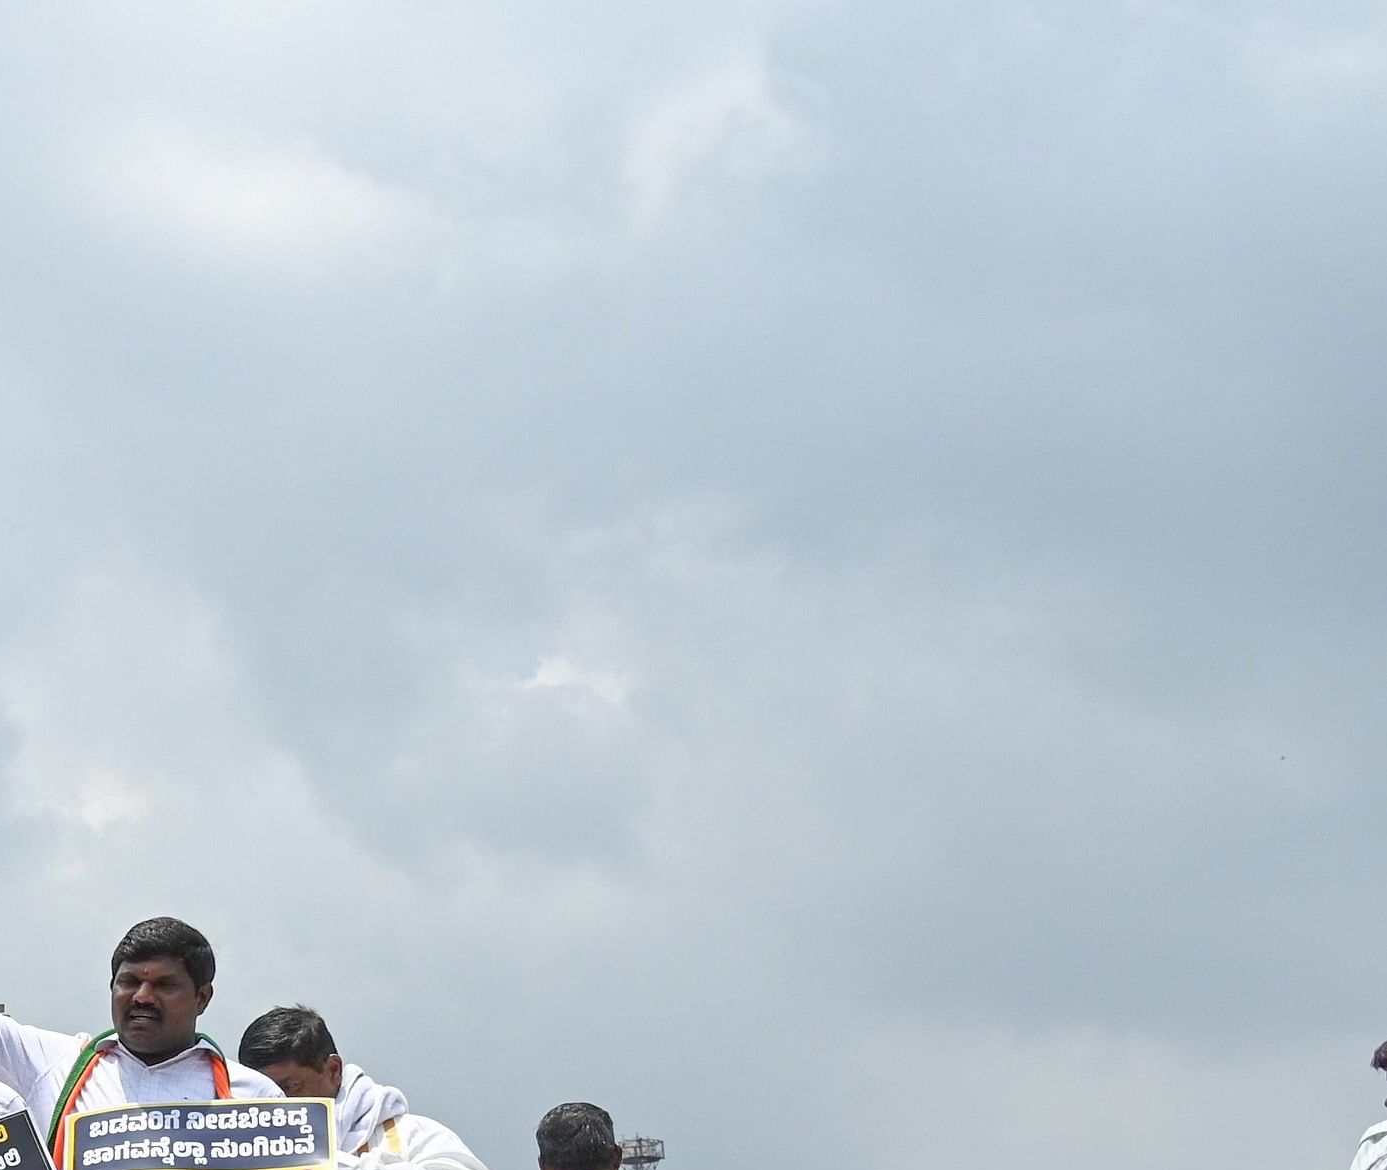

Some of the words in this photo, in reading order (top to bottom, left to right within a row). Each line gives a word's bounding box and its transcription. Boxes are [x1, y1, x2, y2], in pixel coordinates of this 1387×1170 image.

[88, 1110, 181, 1138] ಬಡವರಿಗೆ
[185, 1106, 313, 1134] ನೀಡಬೇಕಿದ್ದ
[82, 1137, 208, 1167] ಜಾಗವನ್ನೆಲ್ಲಾ
[211, 1133, 316, 1159] ನುಂಗಿರುವ
